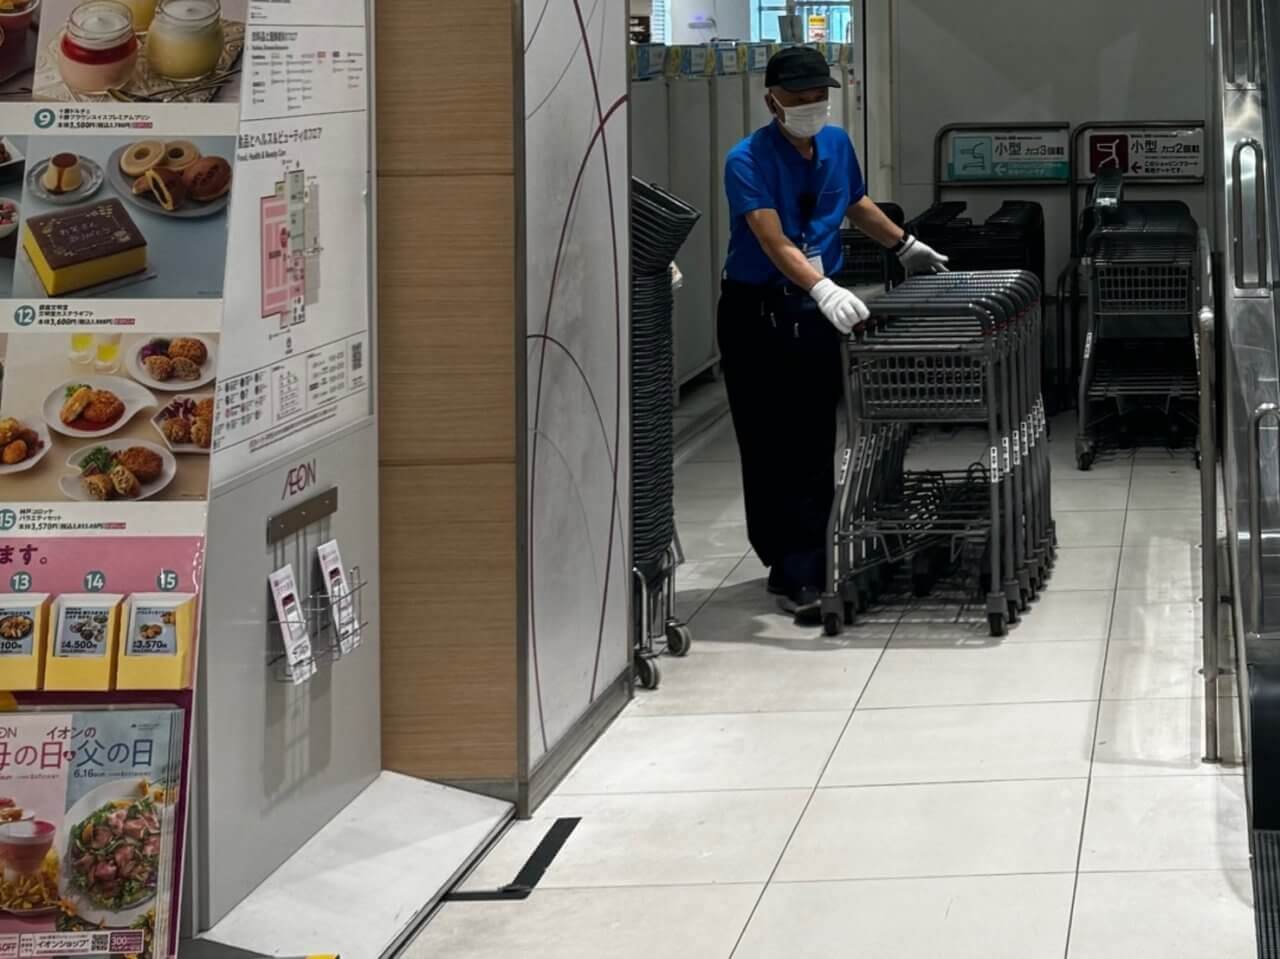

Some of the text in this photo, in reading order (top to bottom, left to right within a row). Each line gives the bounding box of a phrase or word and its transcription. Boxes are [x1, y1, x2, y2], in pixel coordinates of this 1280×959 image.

[39, 112, 51, 126] 9
[994, 141, 1022, 157] 小型
[1131, 139, 1158, 154] 小型
[17, 308, 33, 323] 12
[12, 575, 30, 589] 13
[86, 574, 104, 589] 14
[161, 573, 176, 588] 15
[46, 726, 97, 740] イオンの
[76, 739, 153, 768] 父の日
